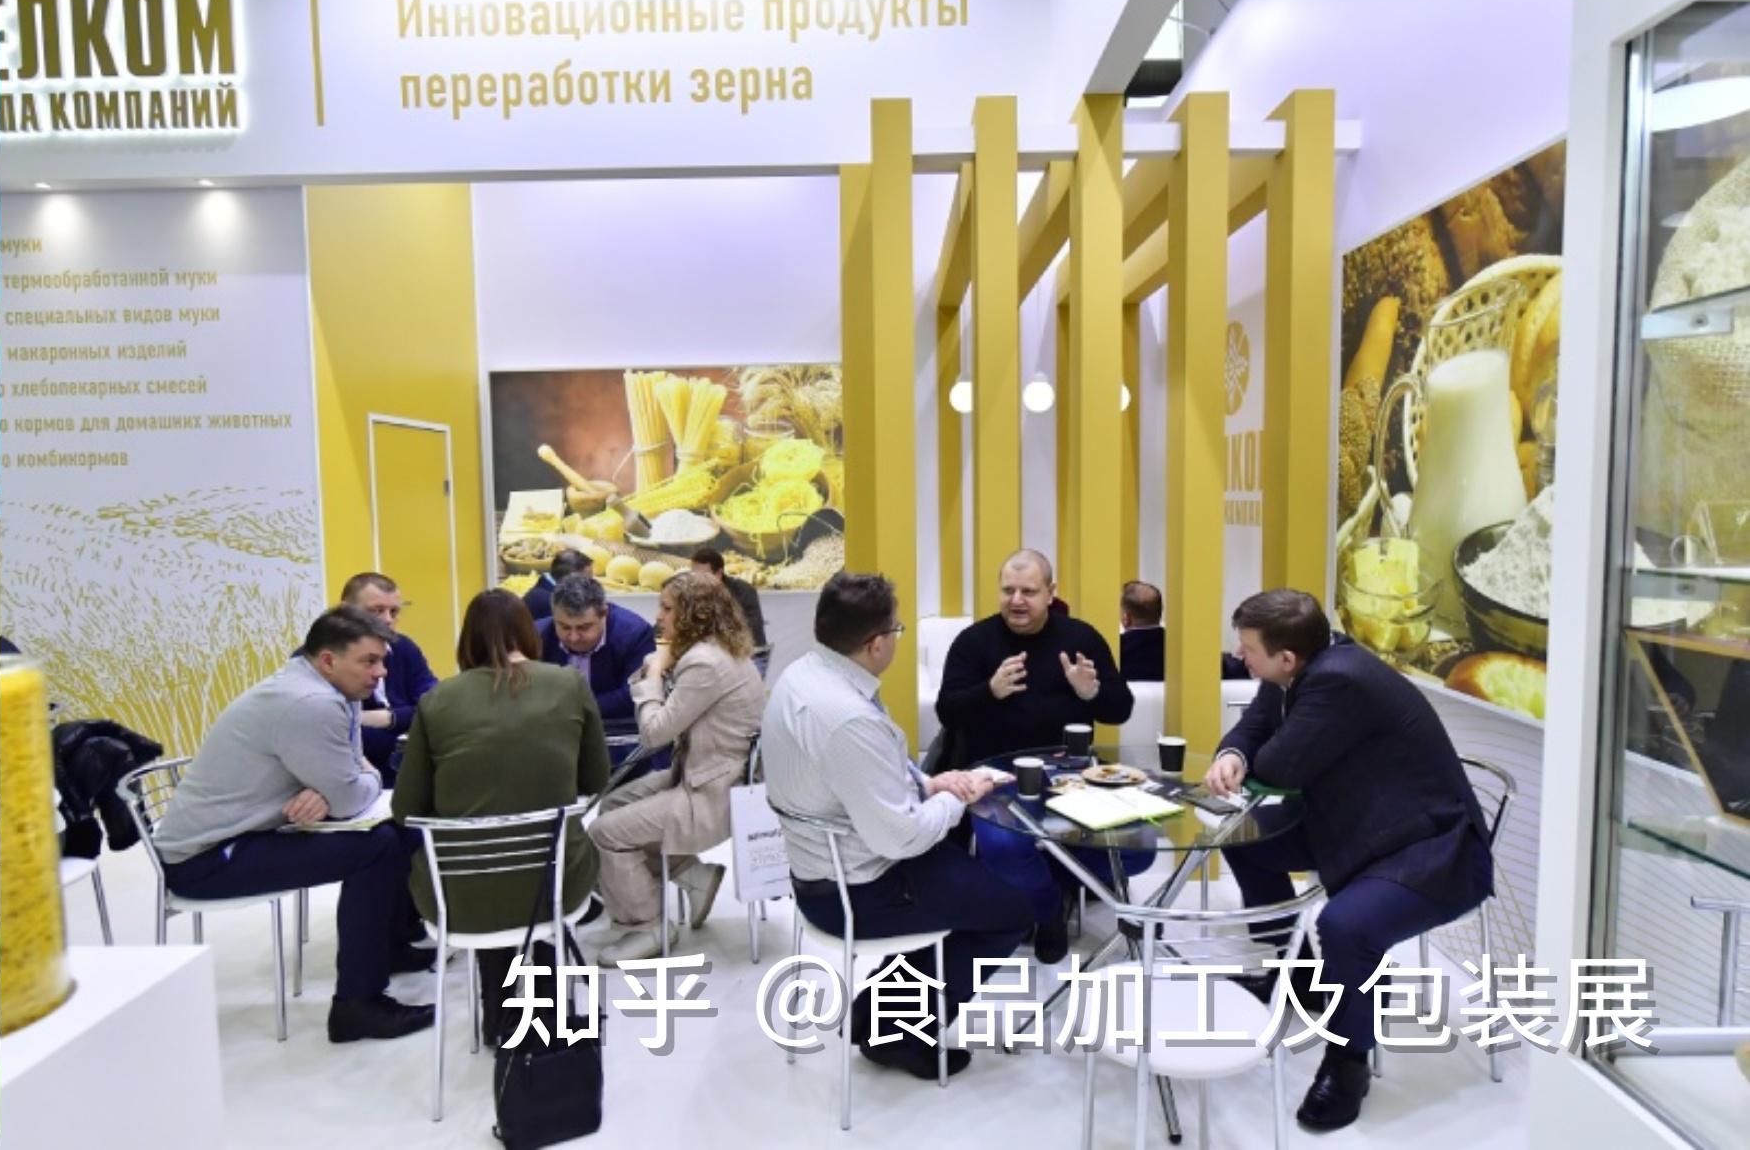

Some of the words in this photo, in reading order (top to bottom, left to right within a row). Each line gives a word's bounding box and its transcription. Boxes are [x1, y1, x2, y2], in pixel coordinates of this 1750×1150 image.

[400, 59, 672, 120] переработки
[690, 65, 813, 115] зерна
[50, 82, 238, 131] КОМПАНИЙ
[0, 236, 42, 258] муки
[2, 267, 169, 293] термообработанной
[175, 270, 218, 291] муки
[5, 309, 117, 326] специальных
[122, 306, 173, 324] видов
[178, 306, 221, 326] муки
[7, 346, 111, 365] макаронных
[116, 340, 187, 360] изделий
[11, 378, 141, 399] хлебопекарных
[146, 375, 208, 395] смесей
[14, 417, 75, 437] кормов
[79, 416, 110, 433] для
[115, 414, 202, 433] домашних
[207, 413, 293, 429] животных
[16, 450, 129, 471] комбикормов
